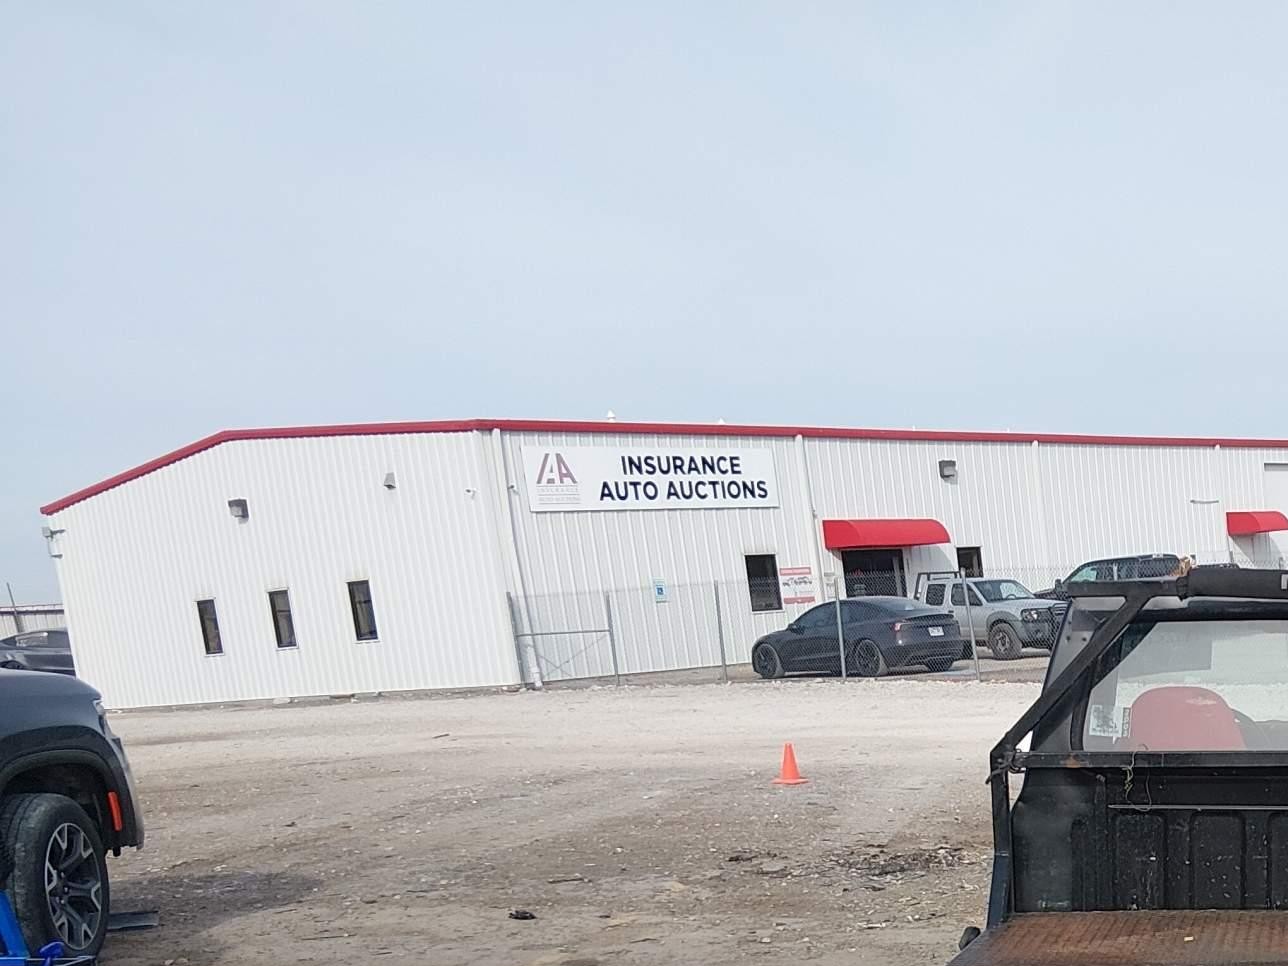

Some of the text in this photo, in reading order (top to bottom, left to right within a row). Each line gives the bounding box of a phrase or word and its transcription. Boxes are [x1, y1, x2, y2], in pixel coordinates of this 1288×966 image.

[621, 455, 742, 475] INSURANCE
[600, 480, 768, 501] AUTO AUCTIONS
